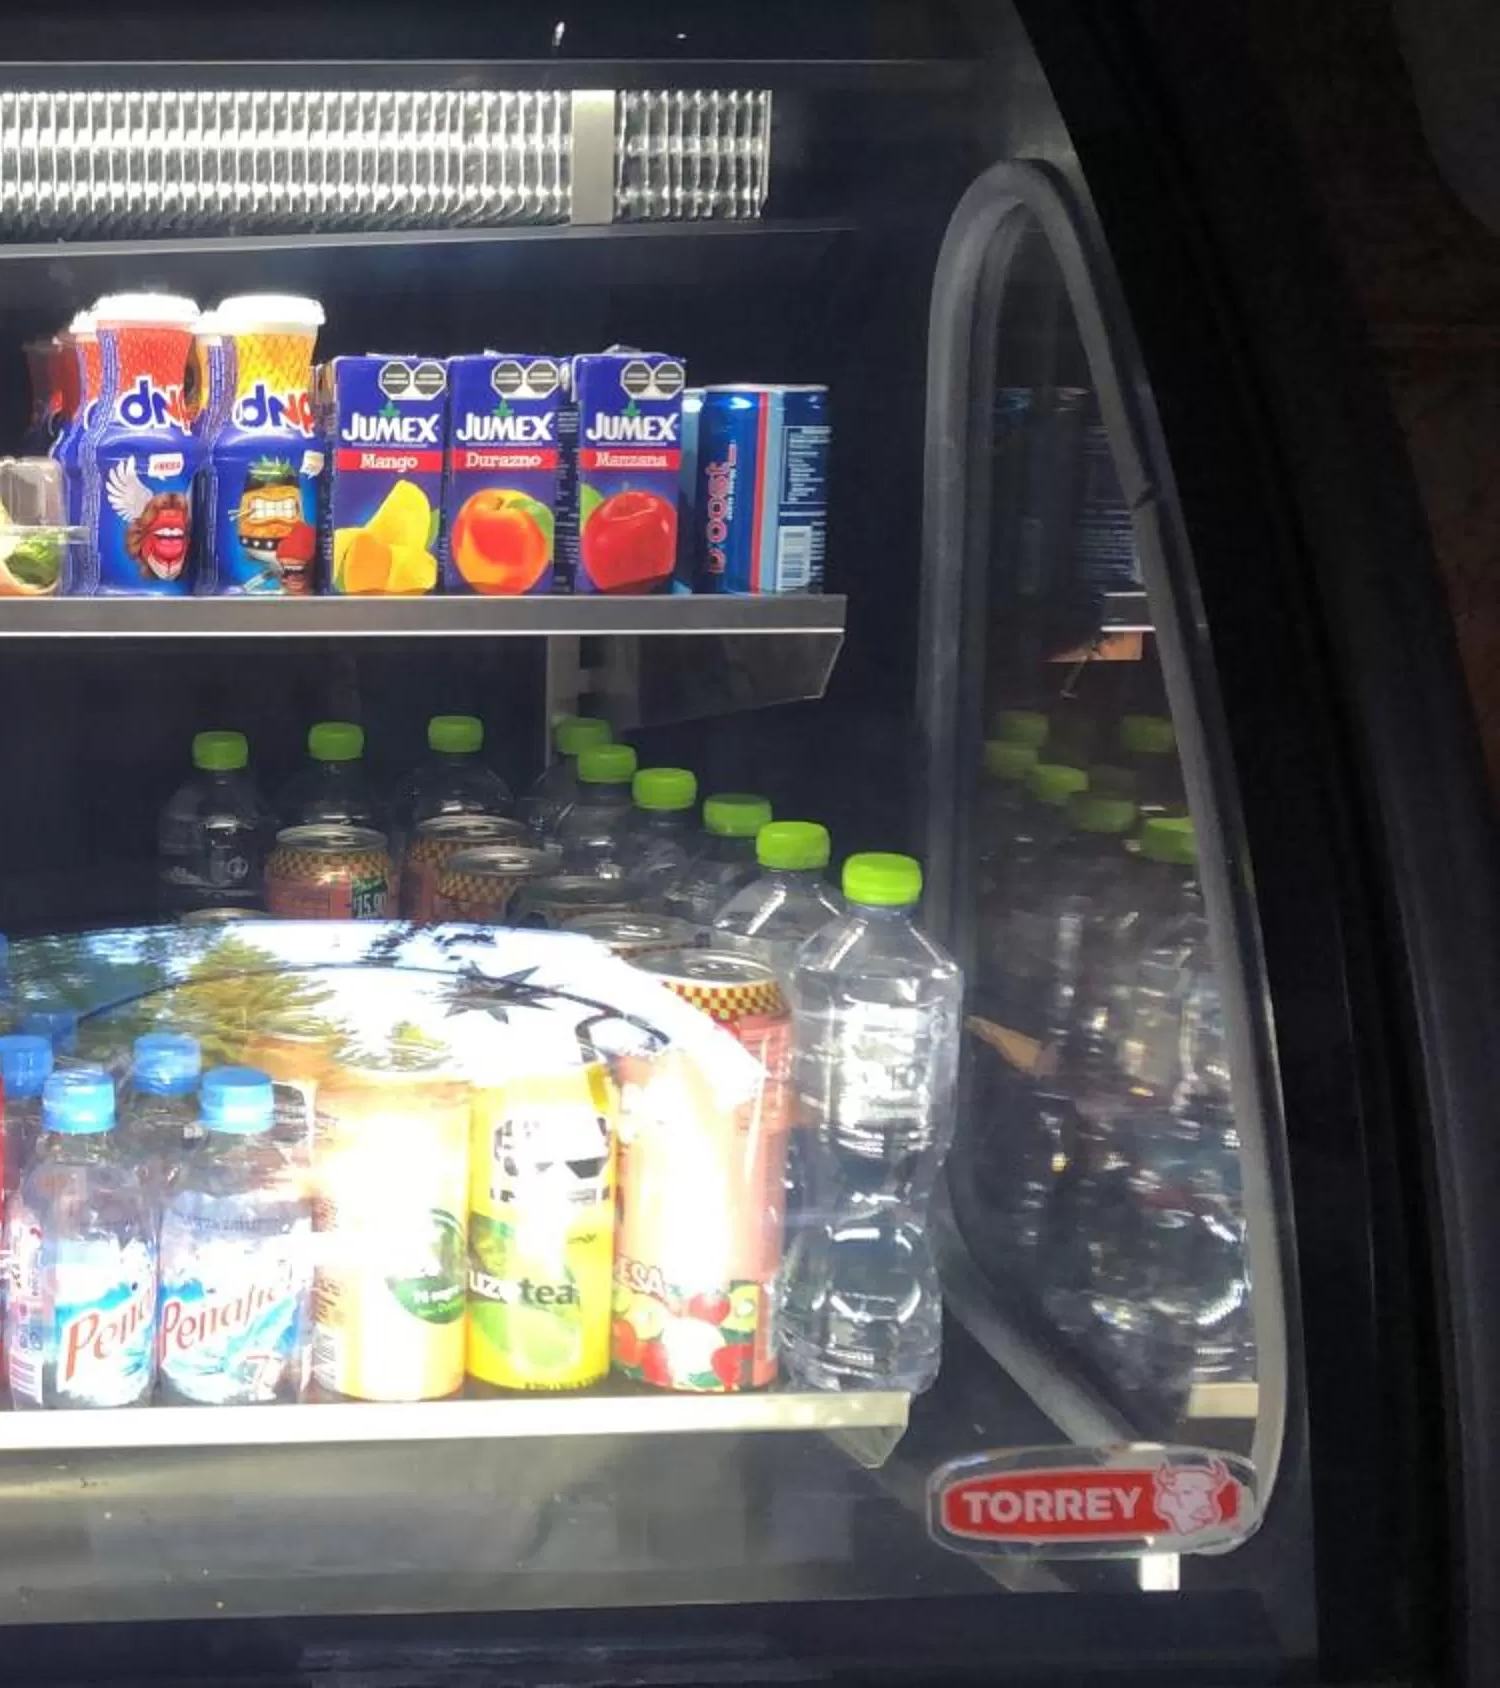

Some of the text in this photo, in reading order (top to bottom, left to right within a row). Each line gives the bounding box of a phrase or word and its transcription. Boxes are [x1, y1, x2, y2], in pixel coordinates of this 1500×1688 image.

[341, 412, 440, 443] JUMEX
[456, 412, 555, 441] JUMEX
[586, 412, 679, 441] JUMEX
[360, 452, 419, 473] Mango
[465, 452, 542, 468] Durazno
[595, 452, 669, 468] Manzana
[518, 1277, 574, 1305] tea
[961, 1486, 1143, 1524] TORREY
